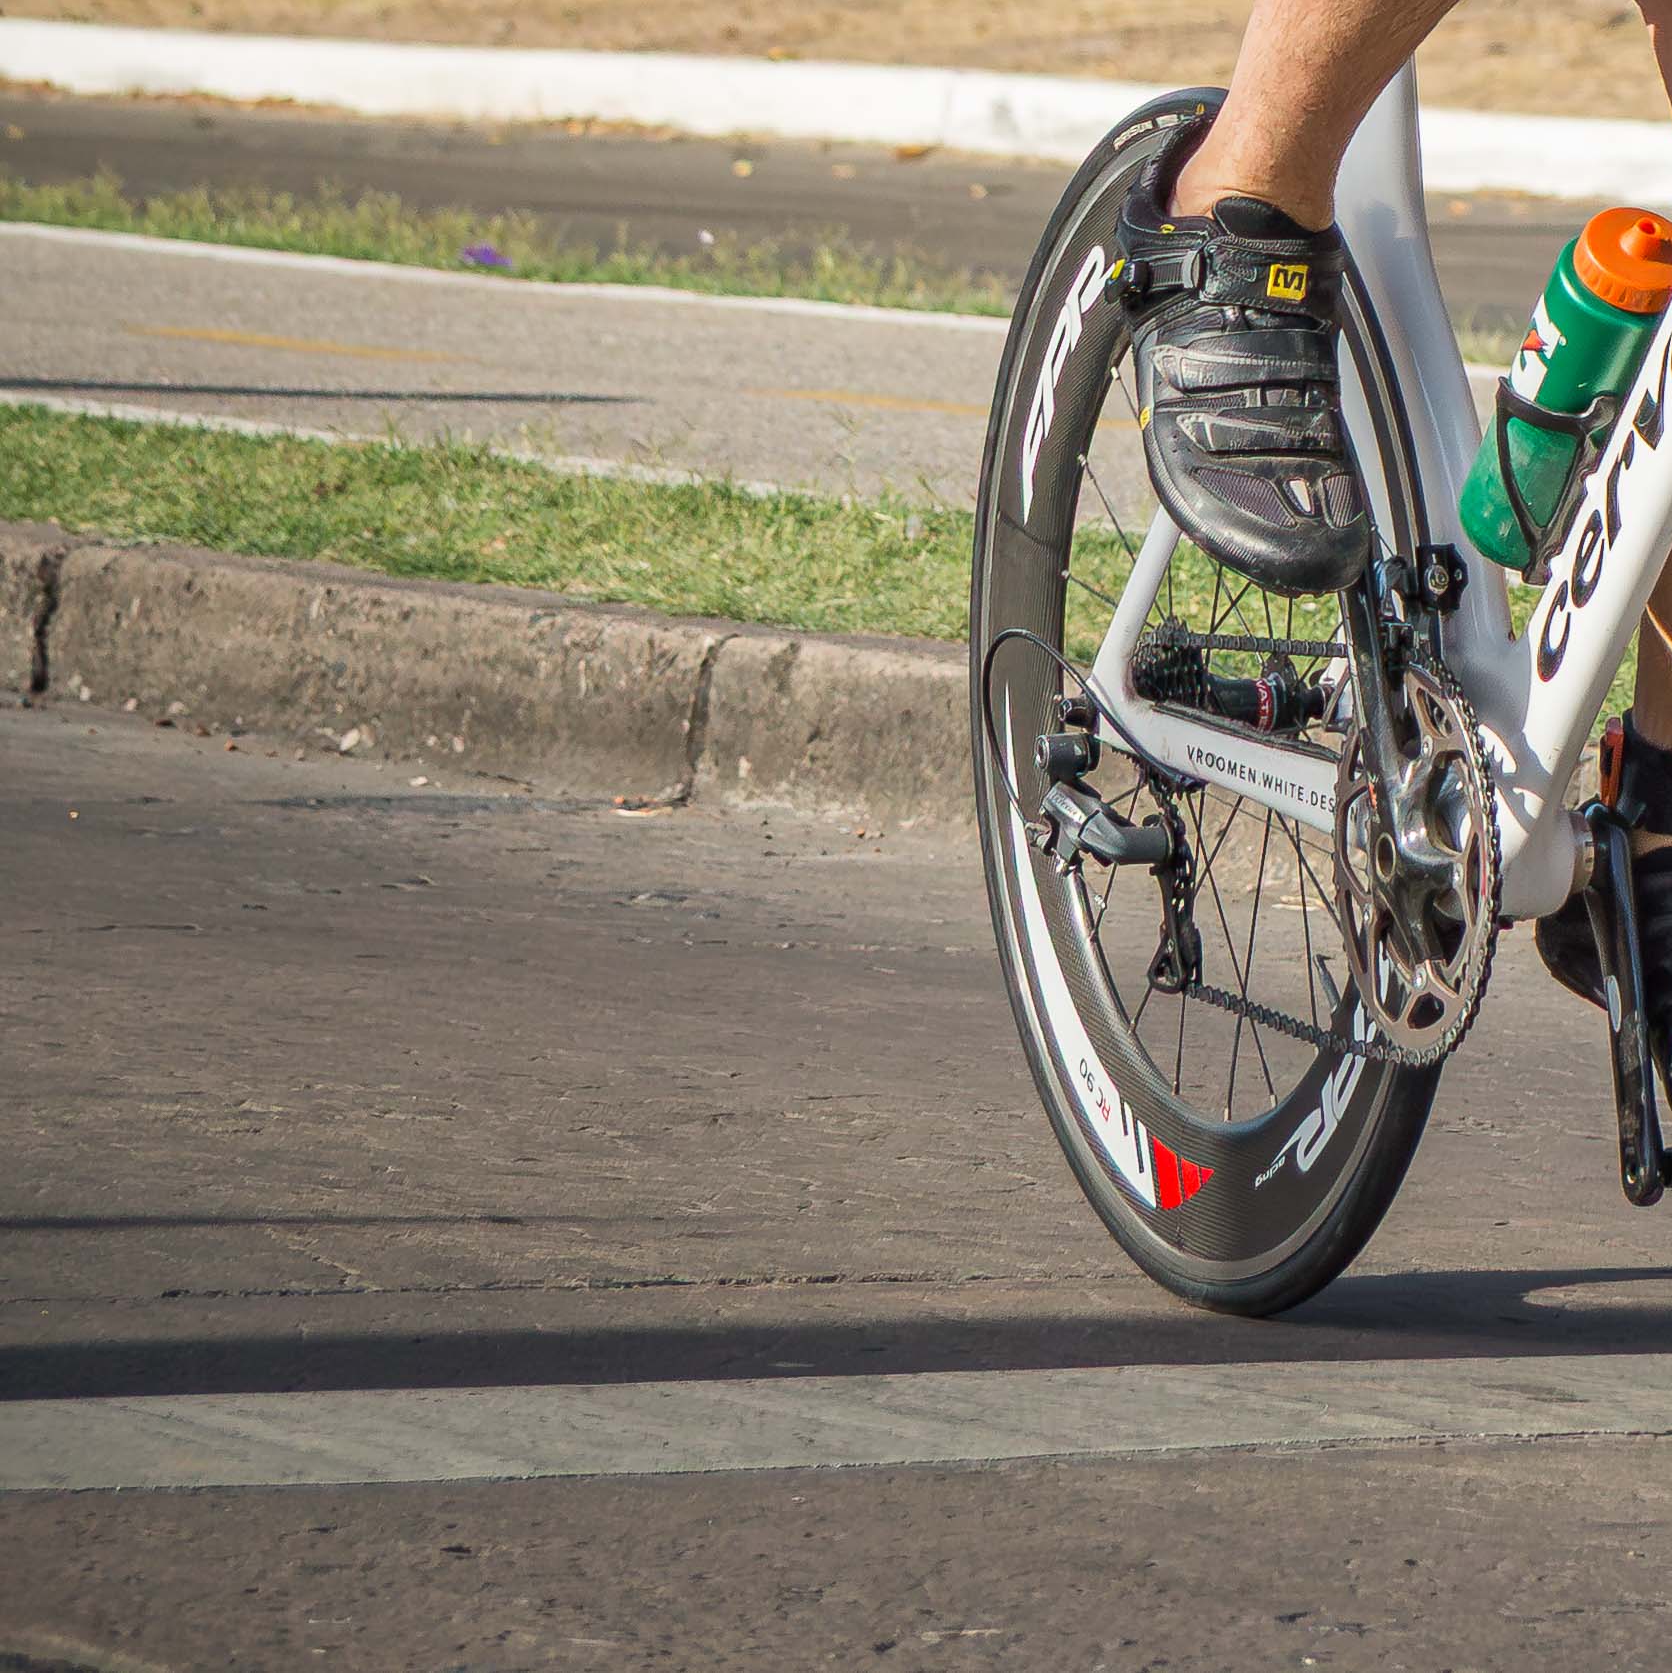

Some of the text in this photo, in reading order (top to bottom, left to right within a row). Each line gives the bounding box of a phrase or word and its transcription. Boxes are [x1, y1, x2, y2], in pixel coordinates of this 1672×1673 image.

[1272, 268, 1305, 291] M
[1079, 1057, 1111, 1123] RC 90
